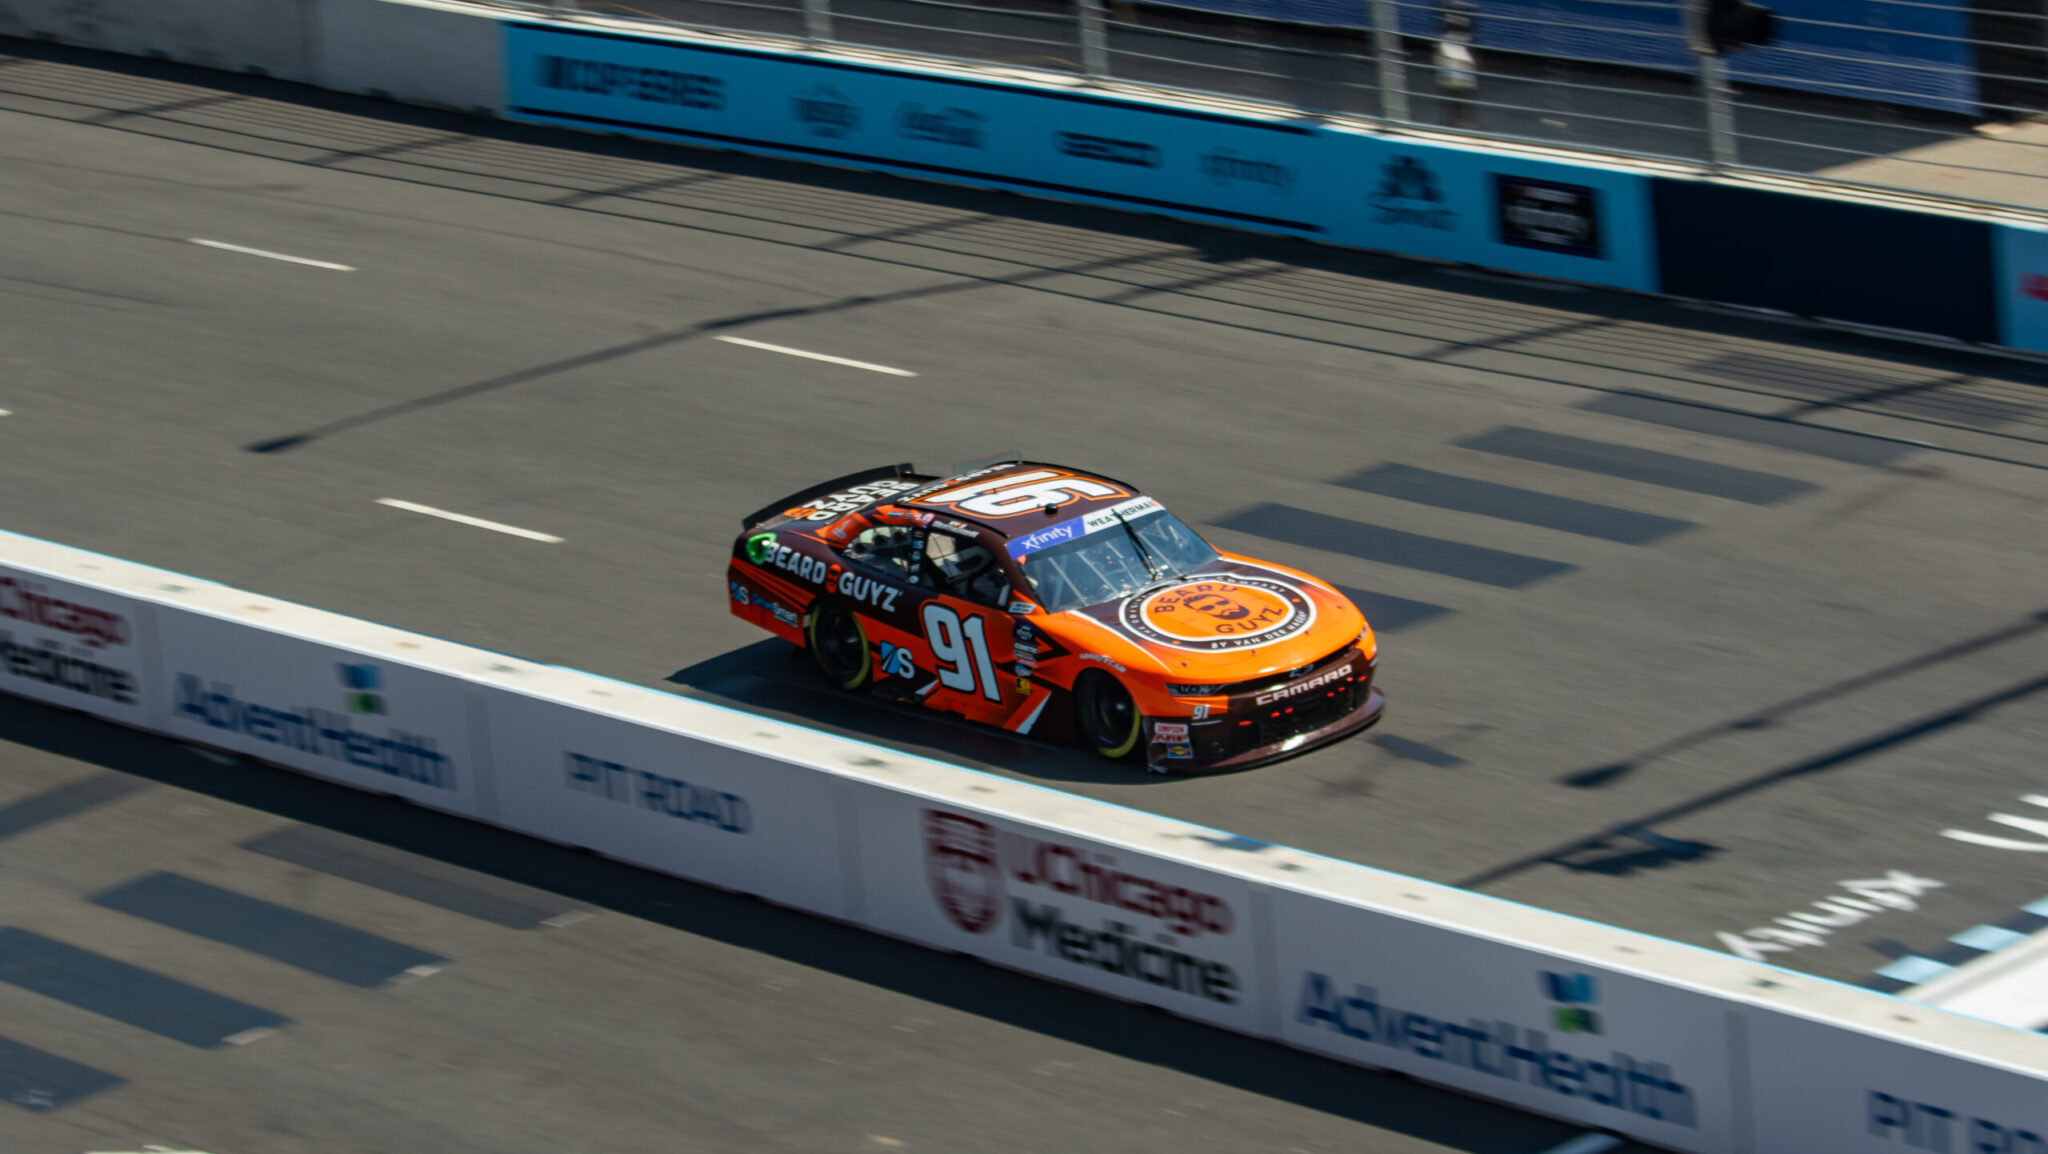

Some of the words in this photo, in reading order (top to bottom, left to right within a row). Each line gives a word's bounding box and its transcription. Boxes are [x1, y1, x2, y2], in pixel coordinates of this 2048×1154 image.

[1021, 525, 1073, 549] xfinity
[763, 541, 827, 584] BEARD
[839, 571, 899, 613] GUYZ
[1211, 641, 1228, 649] BY
[1234, 637, 1260, 647] VAN
[1264, 629, 1287, 640] DER
[1215, 607, 1282, 633] GUYZ
[923, 602, 1000, 701] 91
[1256, 664, 1352, 705] CAMARO
[1193, 704, 1209, 720] 91
[1010, 897, 1242, 1006] Medicine
[1296, 971, 1698, 1129] AdventHealth
